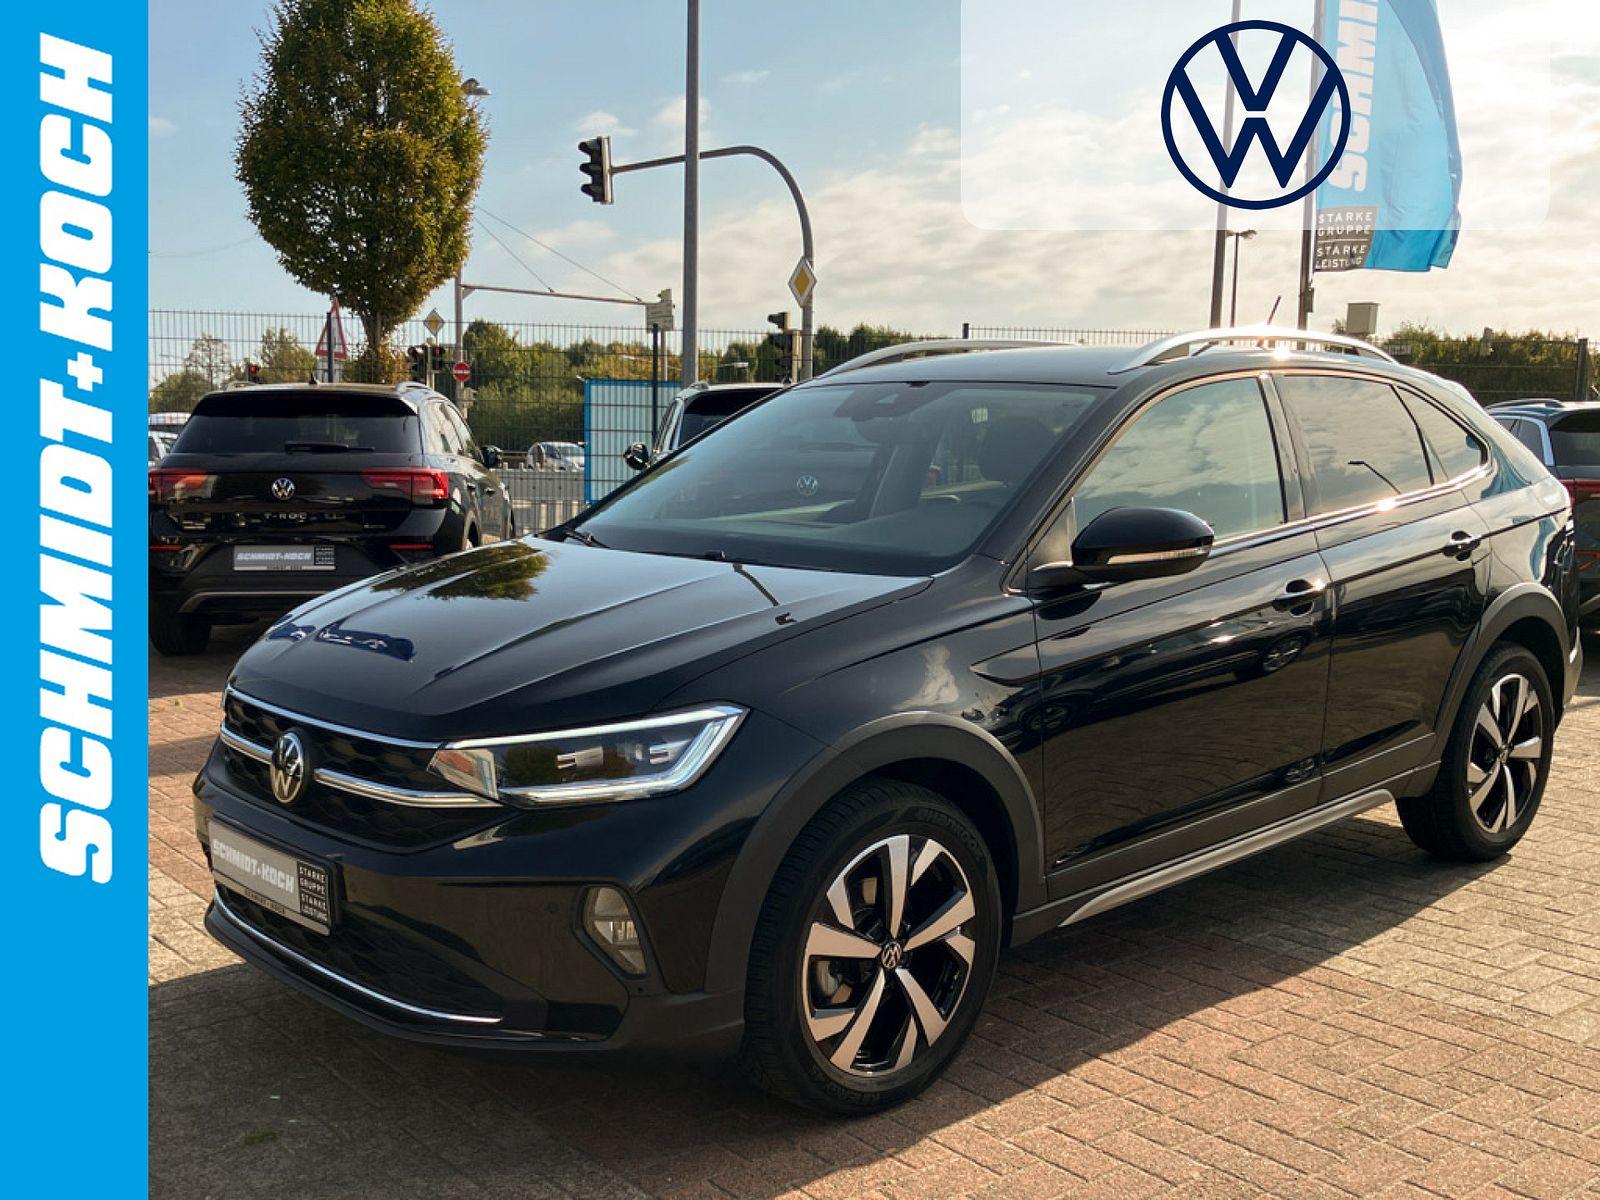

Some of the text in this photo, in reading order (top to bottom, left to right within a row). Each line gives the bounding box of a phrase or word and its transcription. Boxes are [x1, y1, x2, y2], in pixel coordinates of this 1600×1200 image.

[1318, 211, 1373, 224] STARKE
[1317, 224, 1371, 237] GRUPPE
[1316, 244, 1368, 257] STARKE
